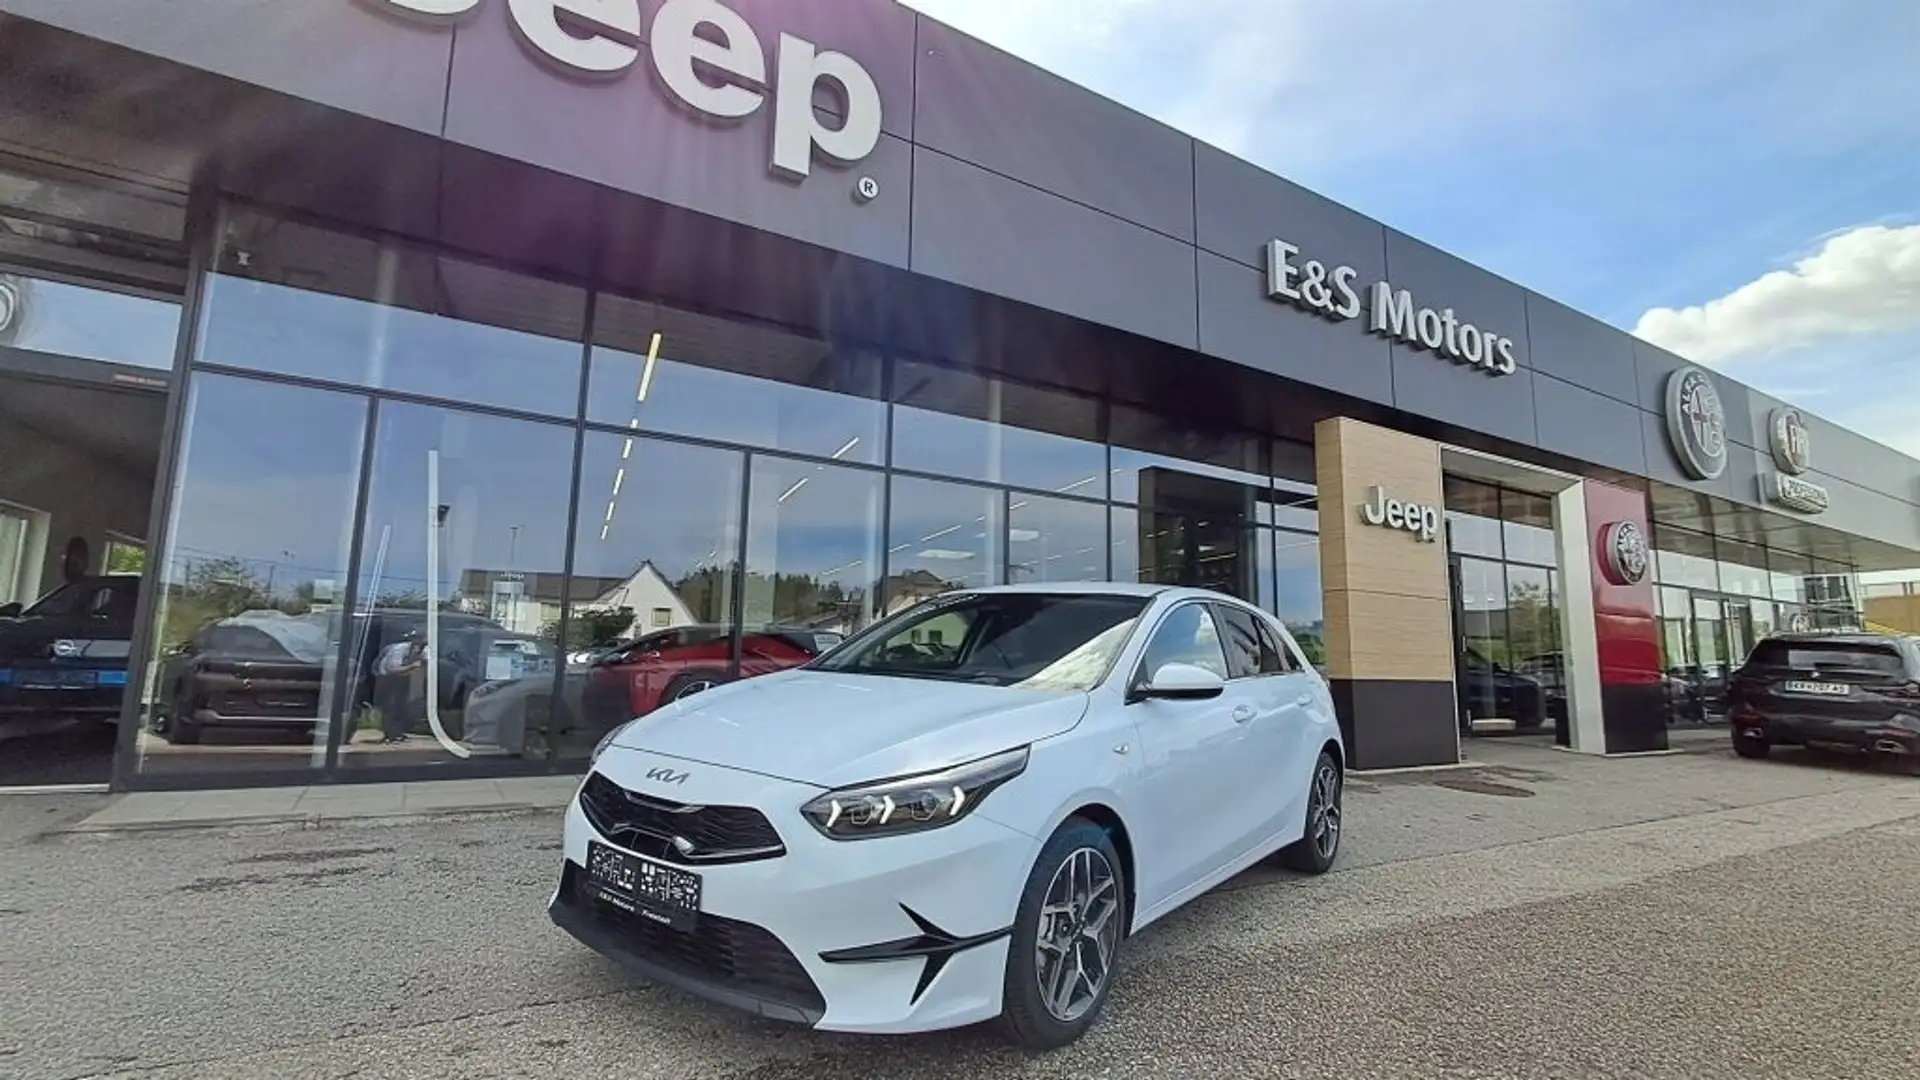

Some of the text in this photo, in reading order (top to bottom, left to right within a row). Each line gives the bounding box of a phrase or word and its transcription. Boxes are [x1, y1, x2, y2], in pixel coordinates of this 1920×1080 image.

[383, 0, 882, 181] eep
[1267, 239, 1516, 375] E&S Motors
[1364, 485, 1438, 541] Jeep
